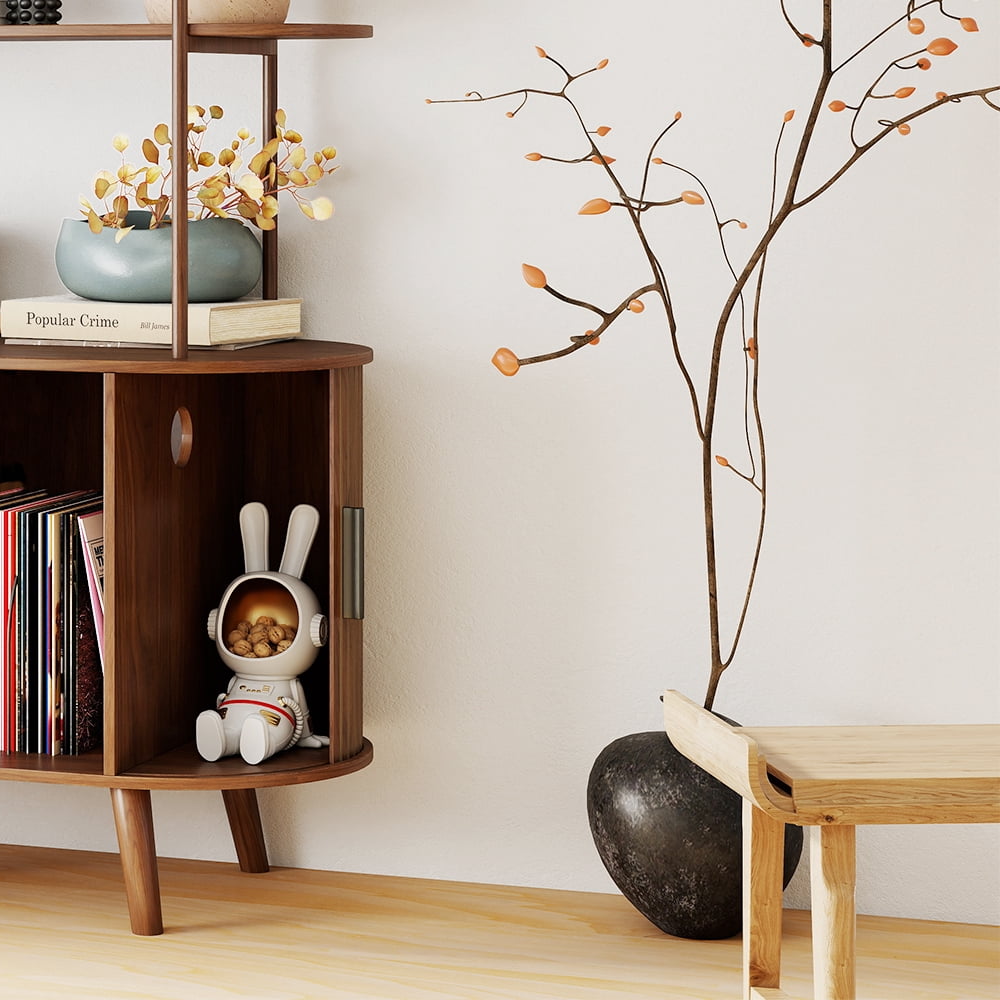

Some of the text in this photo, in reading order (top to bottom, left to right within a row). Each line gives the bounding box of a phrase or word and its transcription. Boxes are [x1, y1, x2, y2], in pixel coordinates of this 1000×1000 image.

[26, 312, 119, 328] Popular Crime
[151, 322, 170, 331] James
